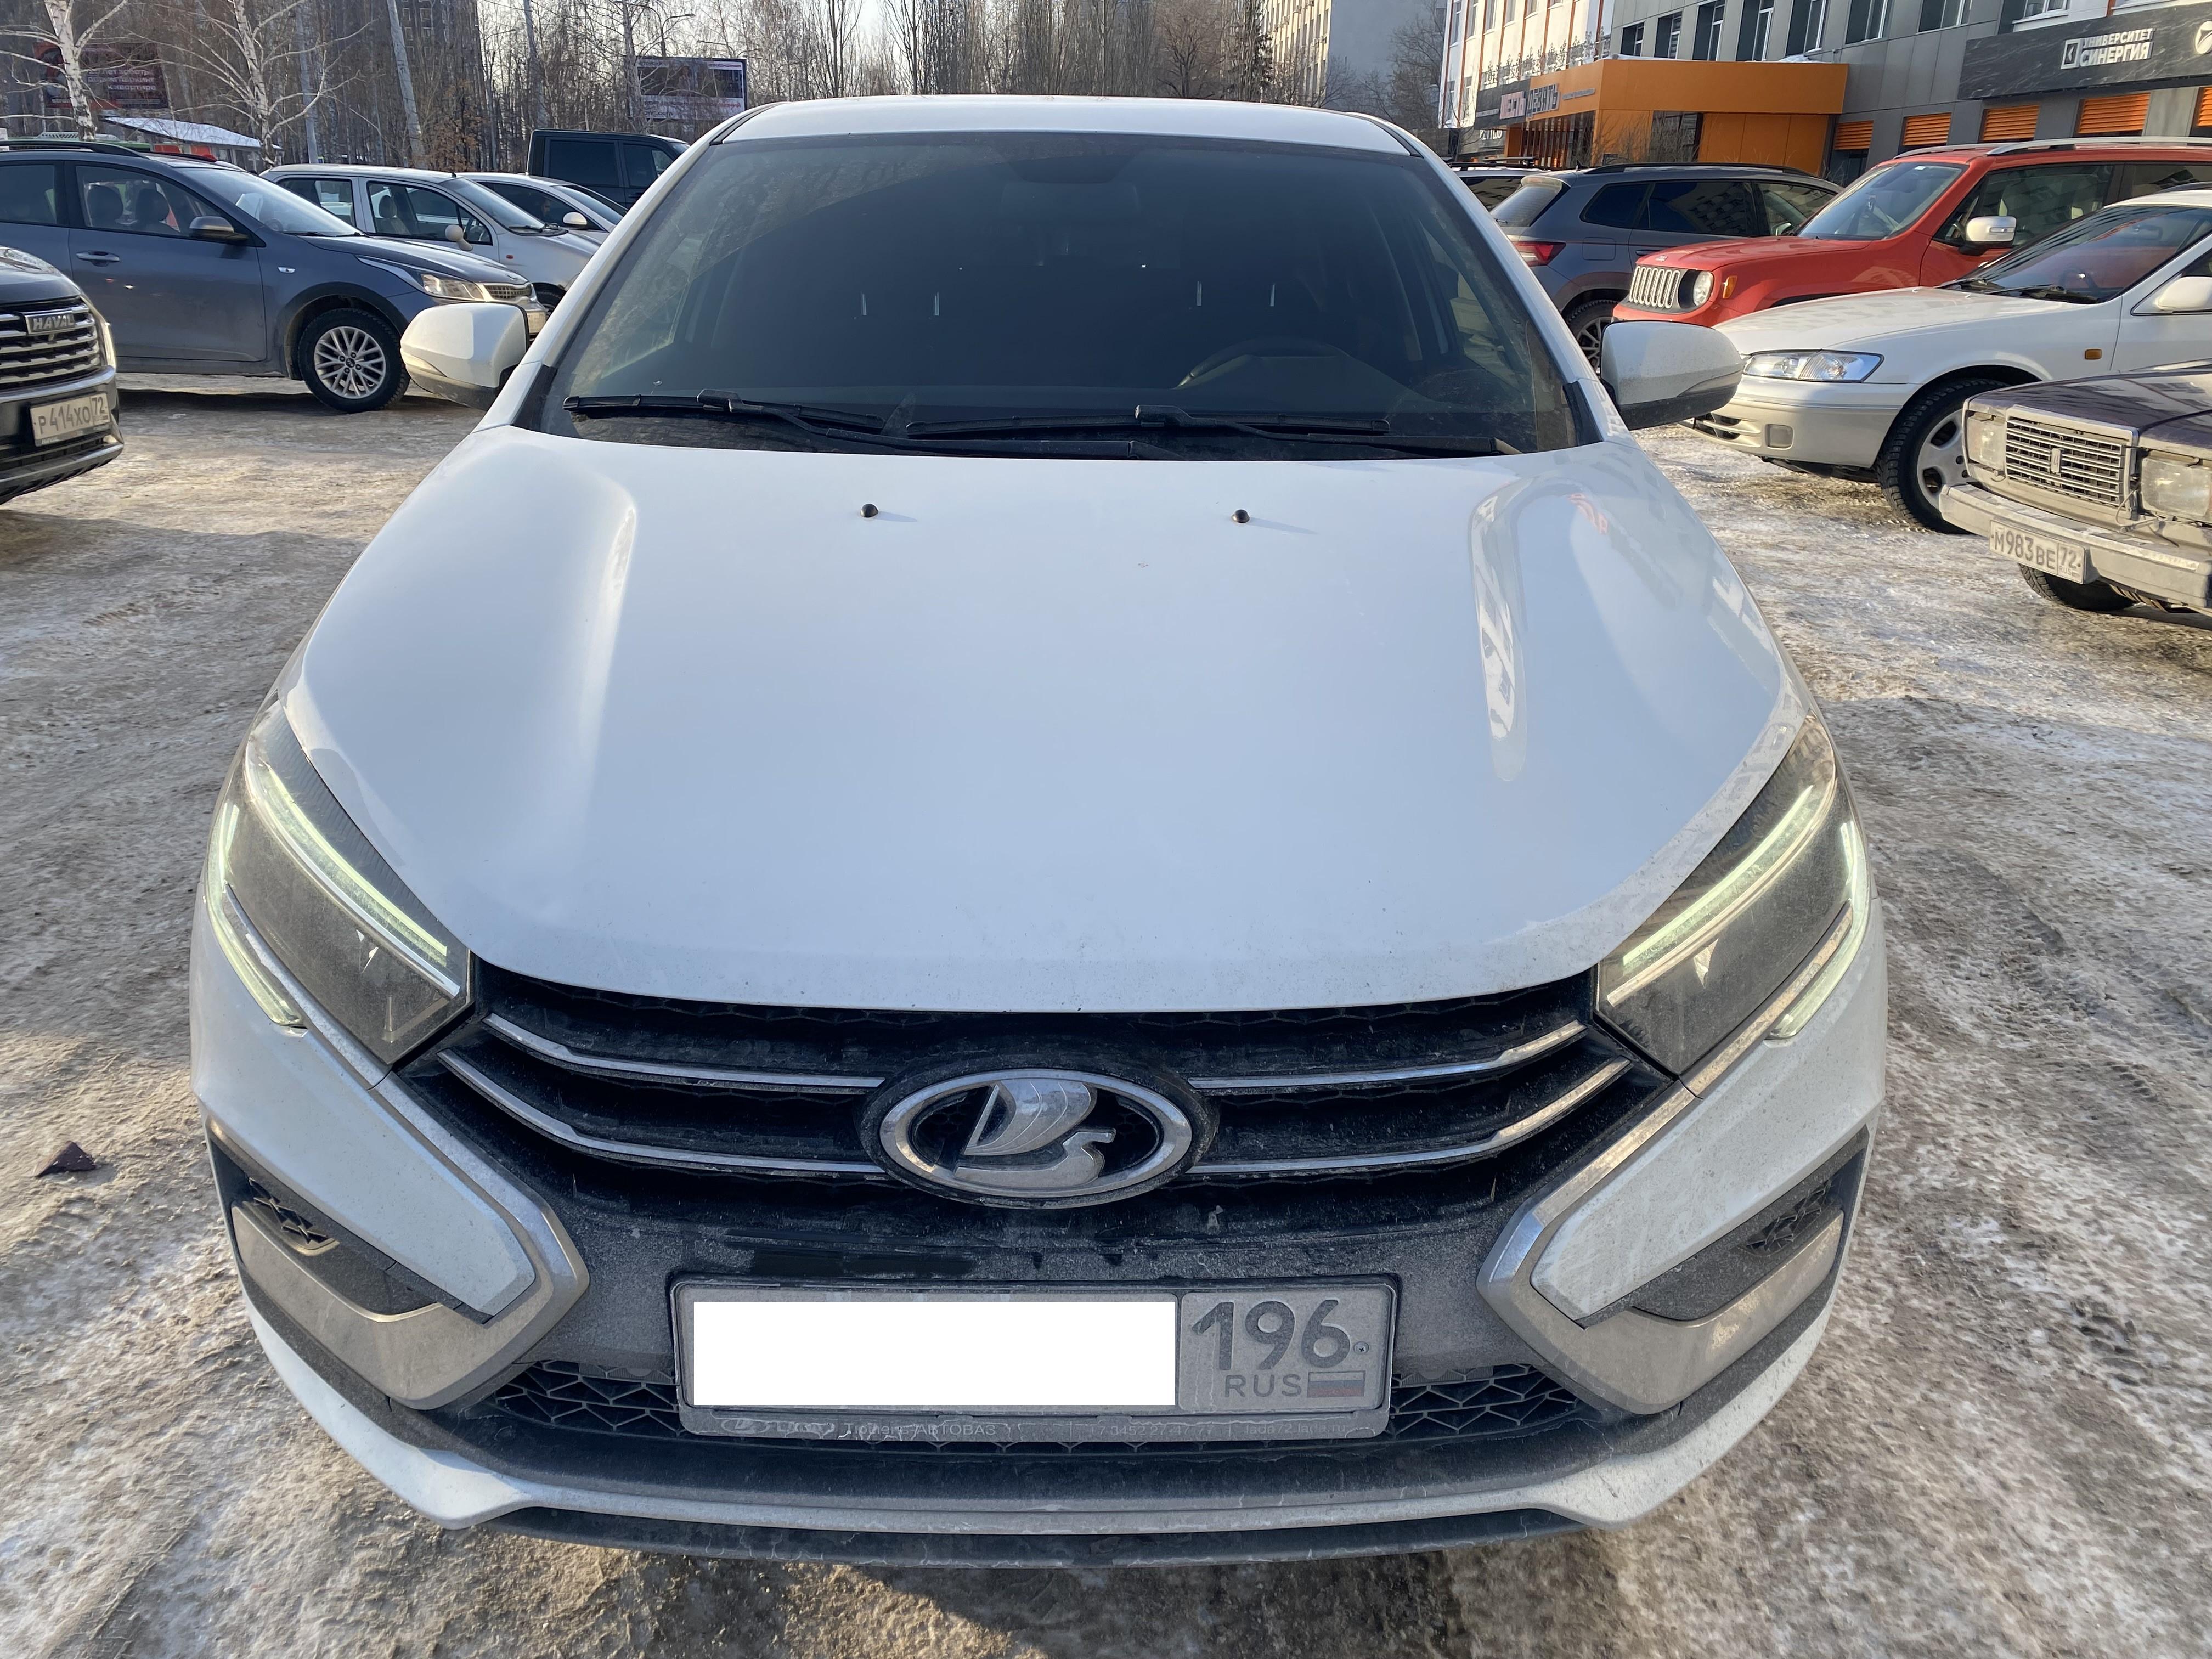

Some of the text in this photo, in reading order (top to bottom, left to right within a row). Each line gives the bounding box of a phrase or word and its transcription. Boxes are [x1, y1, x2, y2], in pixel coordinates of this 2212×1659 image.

[2083, 27, 2155, 48] УНИВЕРСИТЕТ
[2080, 41, 2154, 67] СИНЕРГИЯ
[33, 314, 75, 330] HAVAL
[91, 396, 105, 415] 72
[2061, 546, 2077, 569] 72
[1192, 1299, 1351, 1370] 196
[1224, 1373, 1302, 1398] RUS
